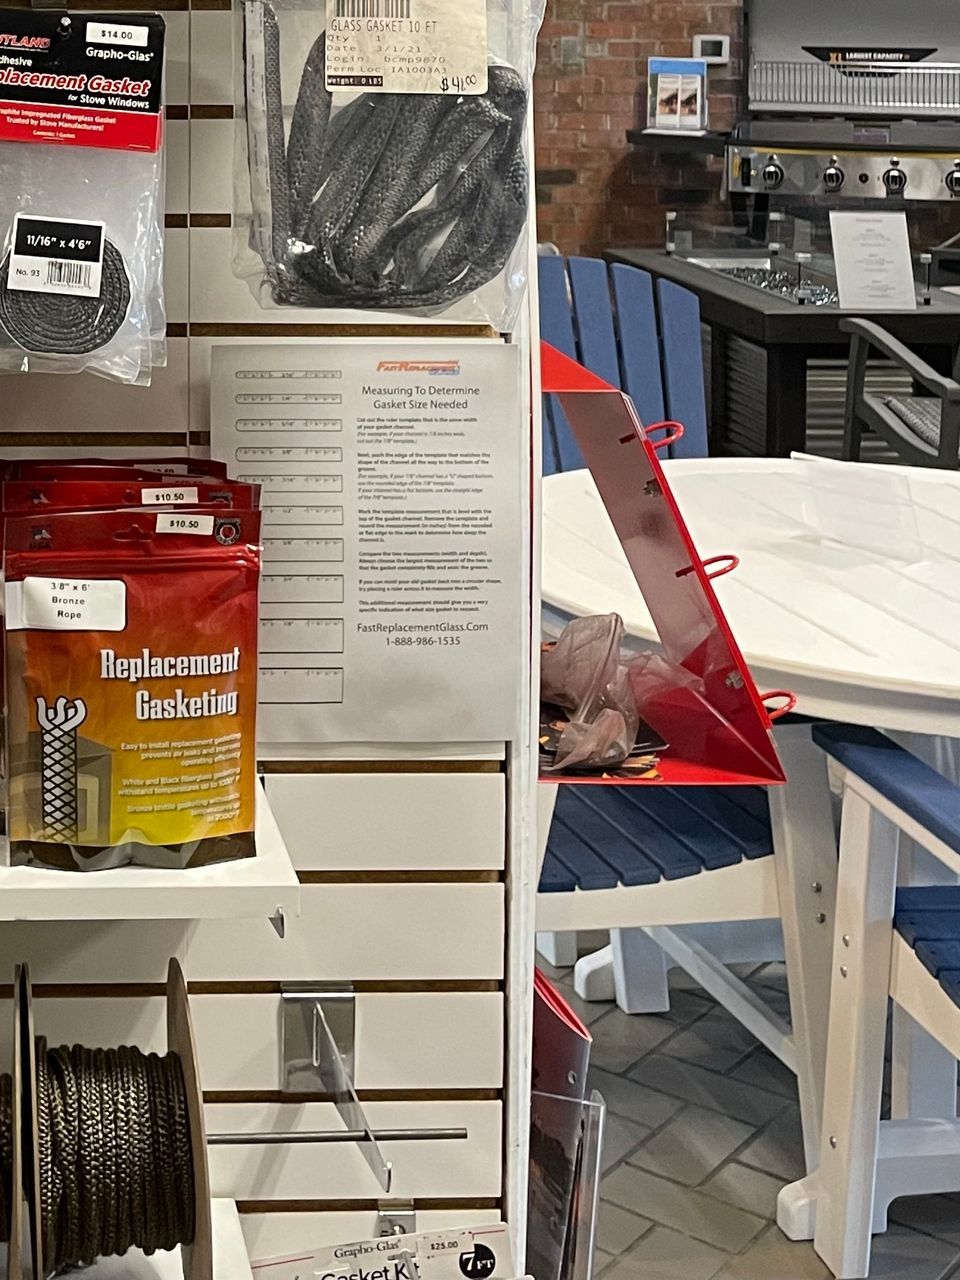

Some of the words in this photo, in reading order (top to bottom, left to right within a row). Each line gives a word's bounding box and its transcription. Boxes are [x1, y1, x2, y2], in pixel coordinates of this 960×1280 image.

[331, 19, 362, 33] GLASS
[366, 20, 403, 33] GASKET
[409, 21, 421, 33] 10
[425, 21, 437, 33] FT
[101, 30, 132, 40] $14.00
[88, 76, 151, 97] Gasket
[68, 94, 78, 102] for
[80, 94, 105, 105] Stove
[108, 96, 150, 109] Windows
[362, 386, 413, 397] Measuring
[415, 386, 427, 395] To
[428, 386, 480, 395] Determine
[373, 400, 407, 409] Gasket
[409, 400, 428, 409] Size
[430, 400, 468, 409] Needed
[155, 493, 184, 501] $10.50
[170, 520, 199, 528] $10.50
[51, 596, 86, 605] Bronze
[57, 610, 82, 620] Rope
[357, 622, 489, 633] FastReplacementGlass.Com
[385, 637, 461, 646] 1-888-986-1535
[100, 646, 241, 682] Replacement
[135, 688, 238, 721] Gasketing
[462, 1254, 476, 1272] 7
